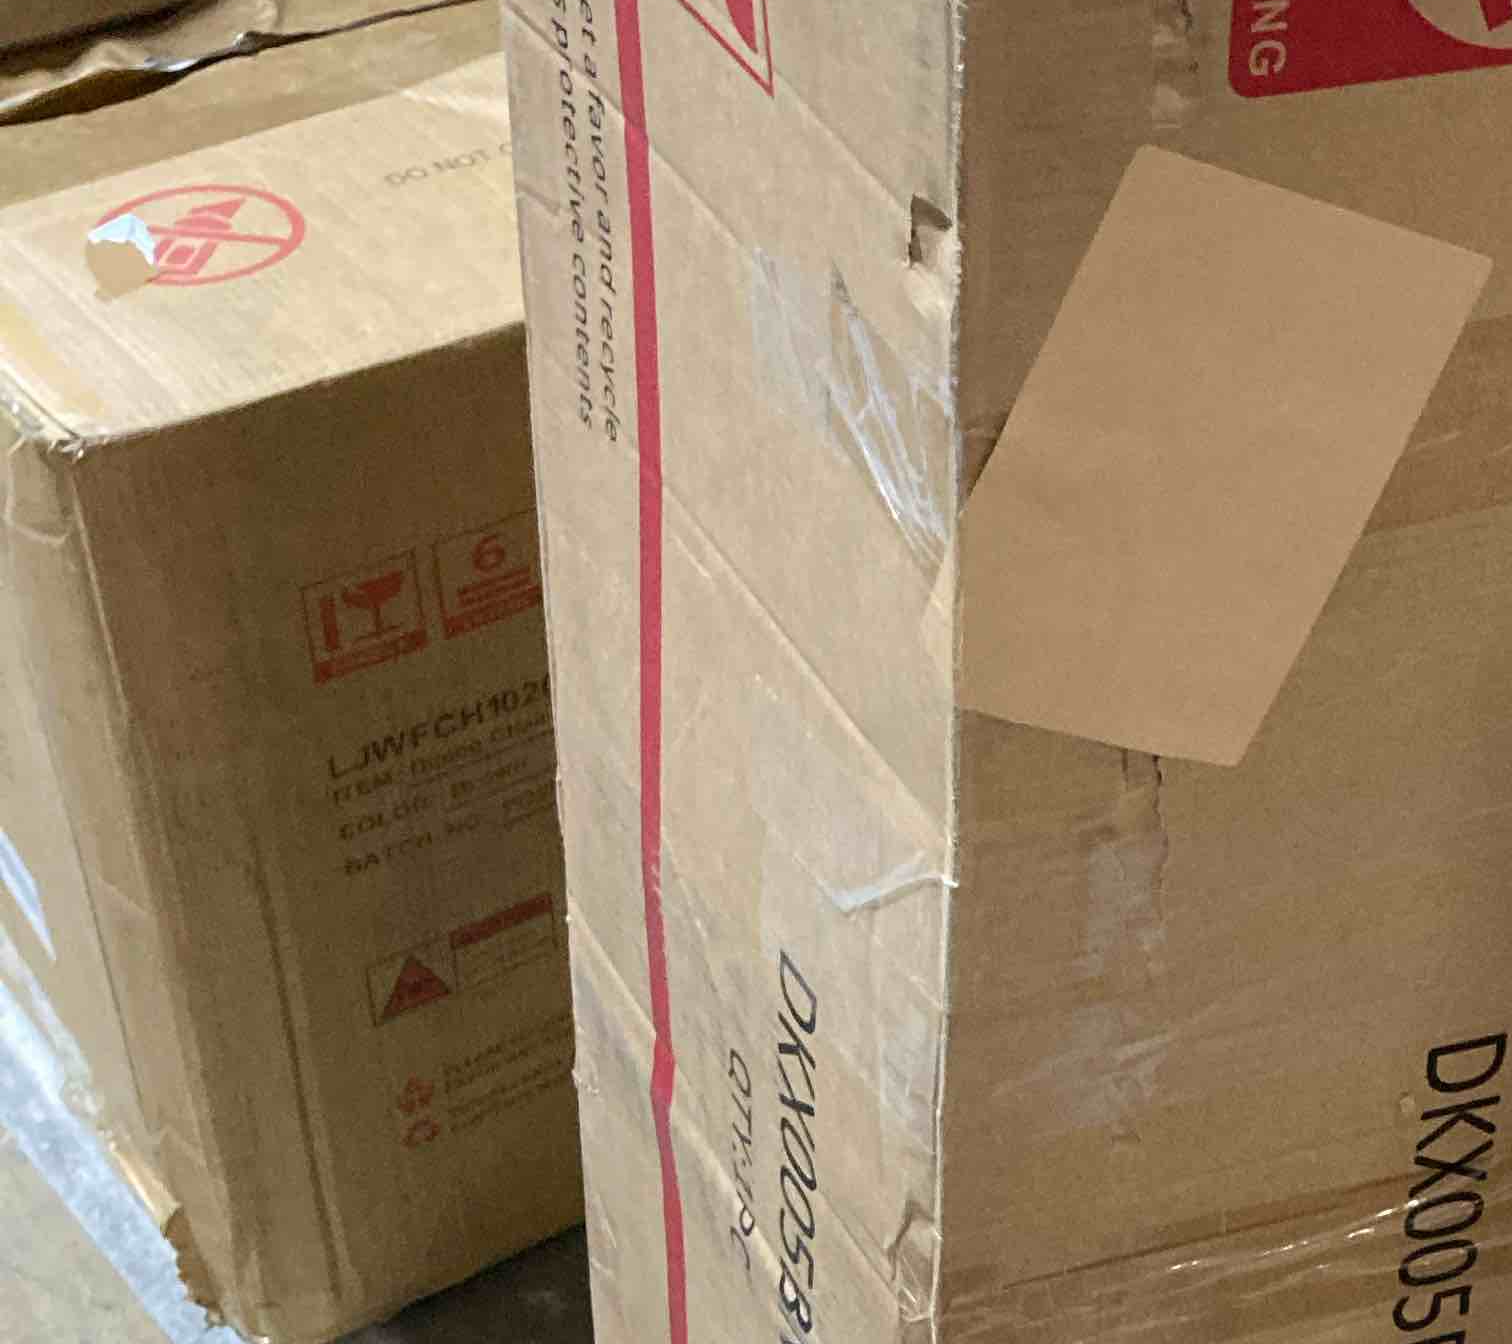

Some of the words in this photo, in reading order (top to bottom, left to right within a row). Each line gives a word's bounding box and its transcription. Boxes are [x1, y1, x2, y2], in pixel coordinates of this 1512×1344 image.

[583, 52, 596, 80] a
[586, 88, 610, 202] favor
[550, 19, 587, 244] protective
[573, 251, 595, 429] contents
[597, 209, 617, 295] and
[598, 298, 622, 444] recycle
[471, 534, 505, 573] 6
[326, 672, 551, 780] LJWFCH102
